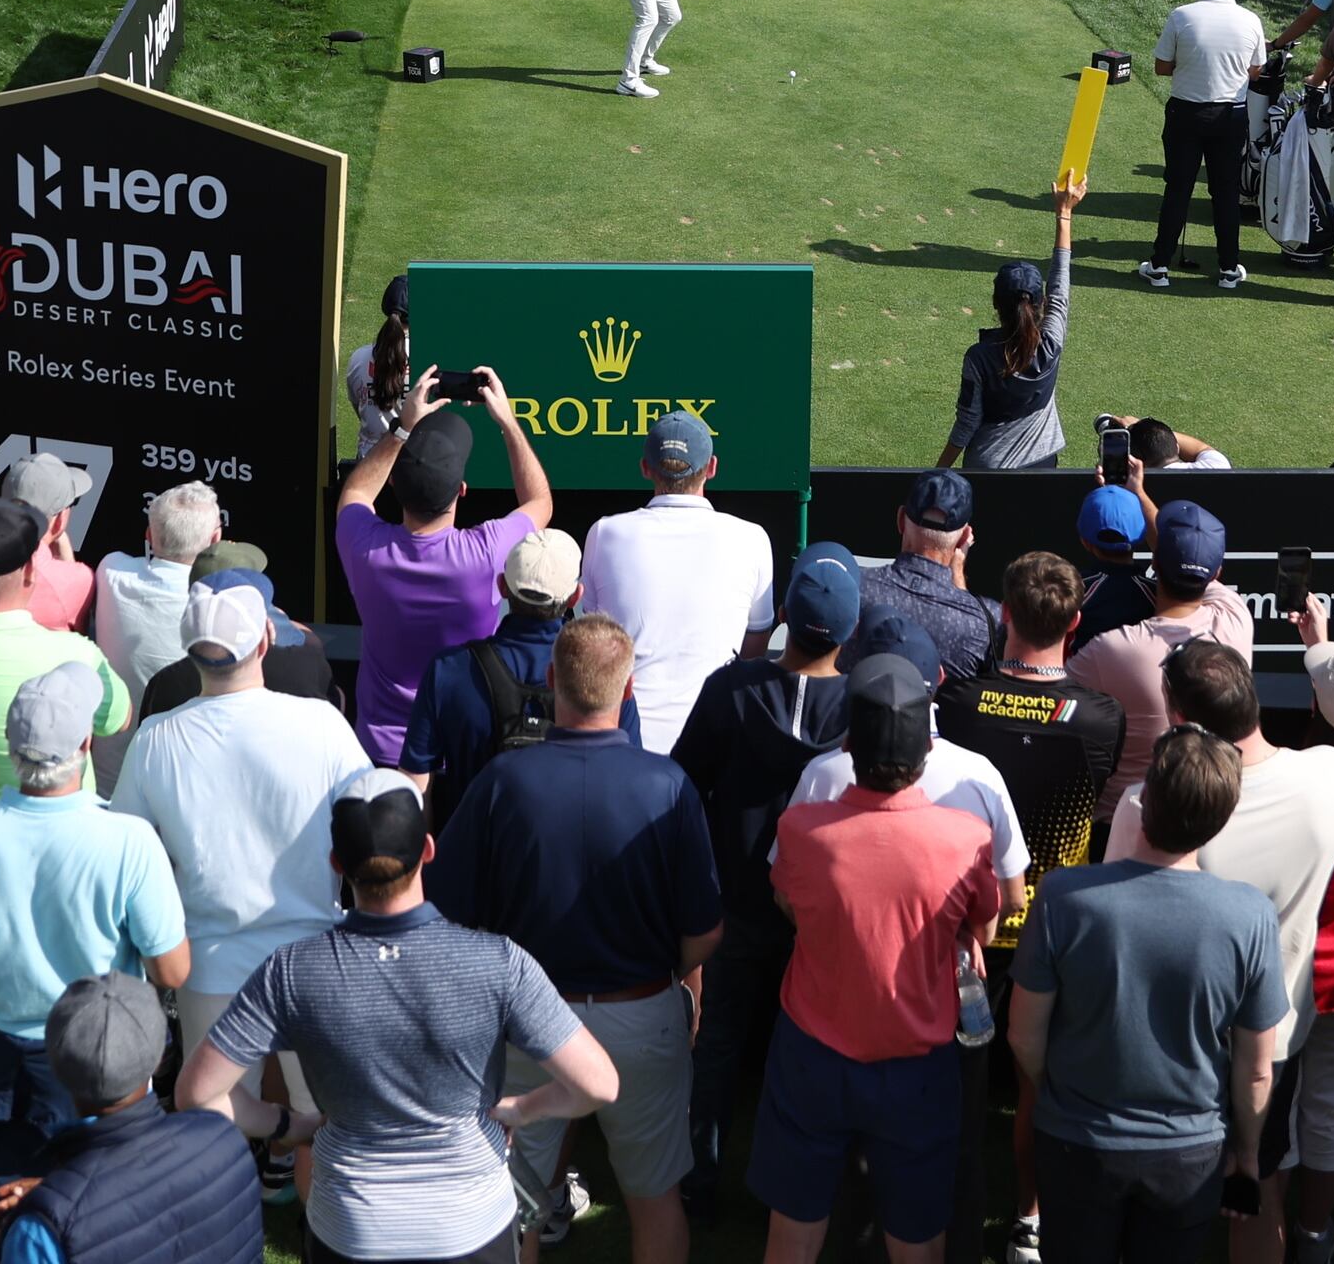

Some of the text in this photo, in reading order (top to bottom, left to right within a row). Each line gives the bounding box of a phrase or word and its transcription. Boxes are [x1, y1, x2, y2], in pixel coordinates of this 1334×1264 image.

[83, 163, 228, 219] Hero
[11, 232, 243, 316] DUBAI
[13, 299, 244, 342] DESERT CLASSIC
[7, 350, 74, 381] Rolex
[81, 358, 157, 391] Series
[165, 367, 237, 399] Event
[507, 397, 719, 436] ROLEX
[141, 443, 253, 482] 359 yds
[977, 701, 1051, 724] academy
[980, 690, 1056, 709] my sports
